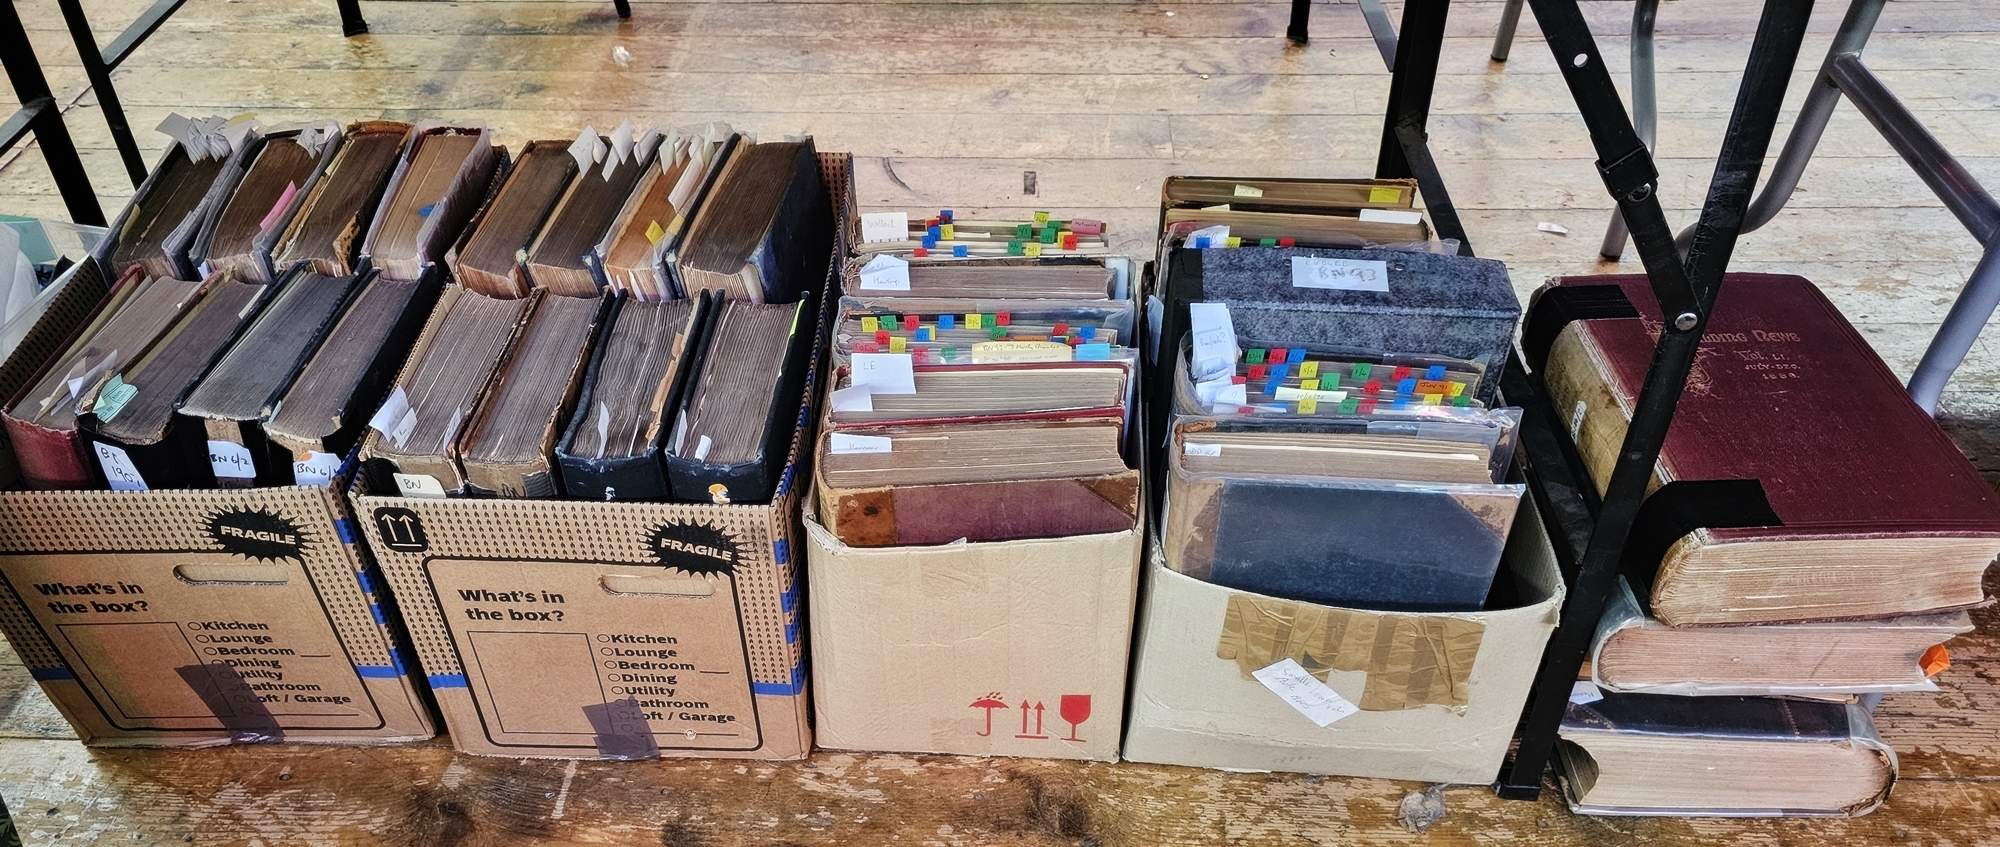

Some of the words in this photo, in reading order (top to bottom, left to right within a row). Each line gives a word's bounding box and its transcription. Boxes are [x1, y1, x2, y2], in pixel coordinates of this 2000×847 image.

[1700, 332, 1748, 343] LDING
[210, 453, 227, 463] BN
[231, 452, 249, 471] 6/2
[296, 463, 317, 474] BN
[403, 478, 421, 490] BN
[220, 525, 297, 545] FRAGILE
[660, 537, 733, 561] FRAGILE
[32, 581, 118, 596] What's
[116, 580, 145, 595] in
[456, 588, 538, 603] What's
[540, 589, 566, 604] in
[46, 600, 90, 614] the
[89, 600, 149, 613] box?
[464, 607, 504, 621] the
[507, 608, 565, 622] box?
[200, 620, 270, 631] Kitchen
[208, 634, 274, 645] Lounge
[611, 633, 678, 645] Kitchen
[215, 646, 296, 656] Bedroom
[614, 647, 678, 659] Lounge
[223, 657, 283, 669] Dining
[618, 660, 696, 671] Bedroom
[621, 673, 678, 685] Dining
[624, 685, 676, 697] Utility
[293, 694, 352, 705] Garage
[678, 711, 737, 724] Garage
